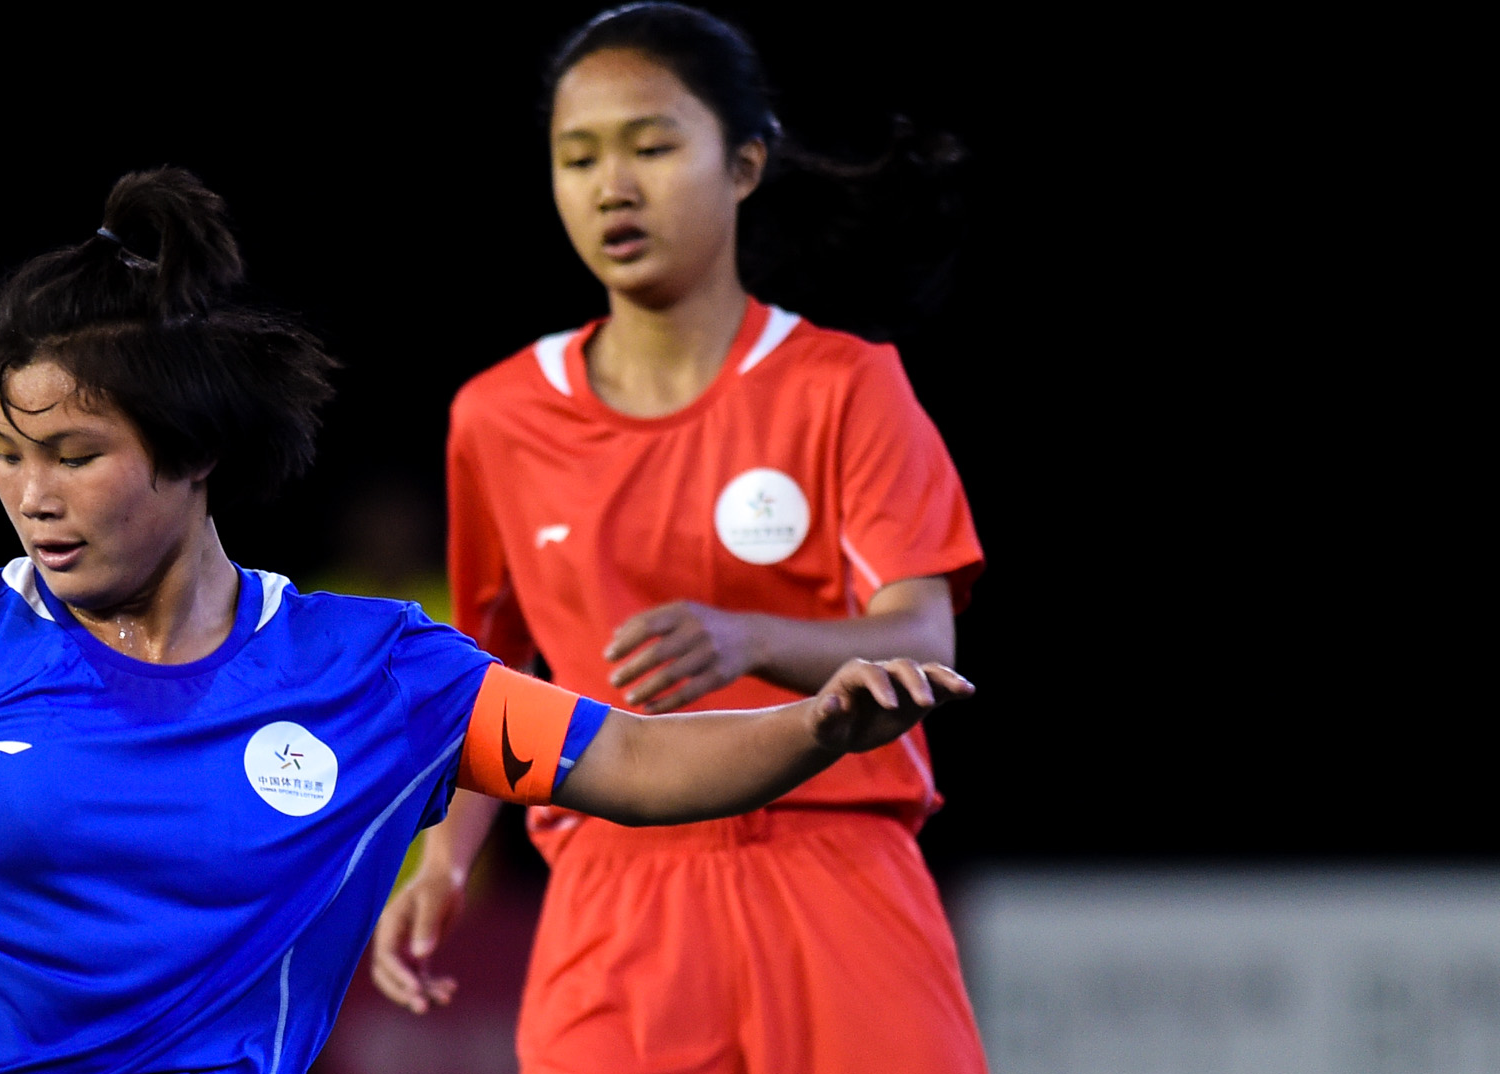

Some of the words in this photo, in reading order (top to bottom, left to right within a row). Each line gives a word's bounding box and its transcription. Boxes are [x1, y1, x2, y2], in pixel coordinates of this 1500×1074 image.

[258, 776, 324, 792] 中国体育彩票
